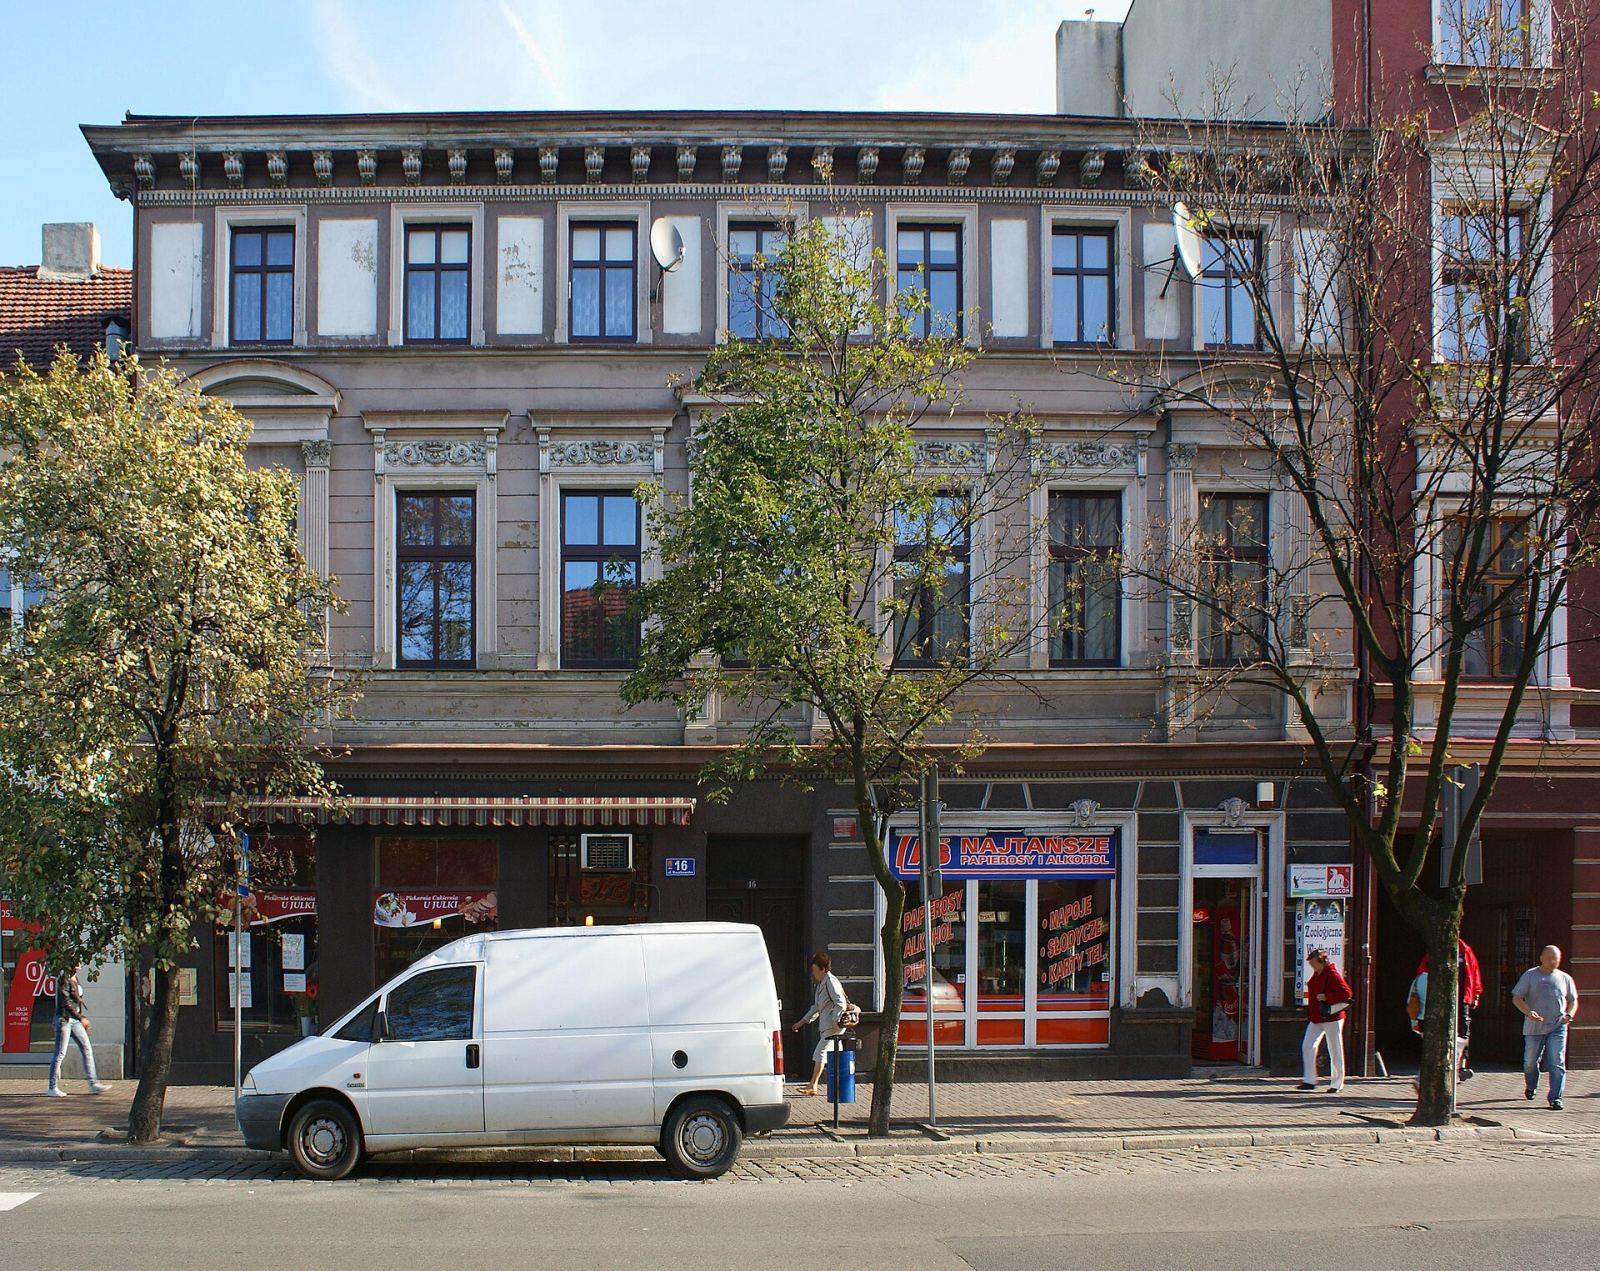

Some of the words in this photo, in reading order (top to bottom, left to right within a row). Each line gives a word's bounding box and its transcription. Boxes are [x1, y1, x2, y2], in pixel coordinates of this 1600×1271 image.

[960, 835, 1110, 854] NAJTAŃSZE
[674, 860, 688, 871] 16
[960, 854, 1034, 866] PAPIEROSY
[1038, 854, 1043, 866] I
[1045, 854, 1110, 866] ALKOHOL
[747, 880, 757, 889] 16
[281, 901, 289, 909] U
[290, 901, 316, 910] JULKI
[423, 901, 430, 909] U
[432, 901, 458, 910] JULKI
[903, 889, 964, 932] PAPEROSY
[1049, 894, 1093, 931] NAPOJE
[903, 921, 954, 958] ALKHOL
[1047, 916, 1104, 959] SŁODYCZE
[1304, 925, 1342, 940] Zoologiczno
[1048, 951, 1084, 985] KARTY
